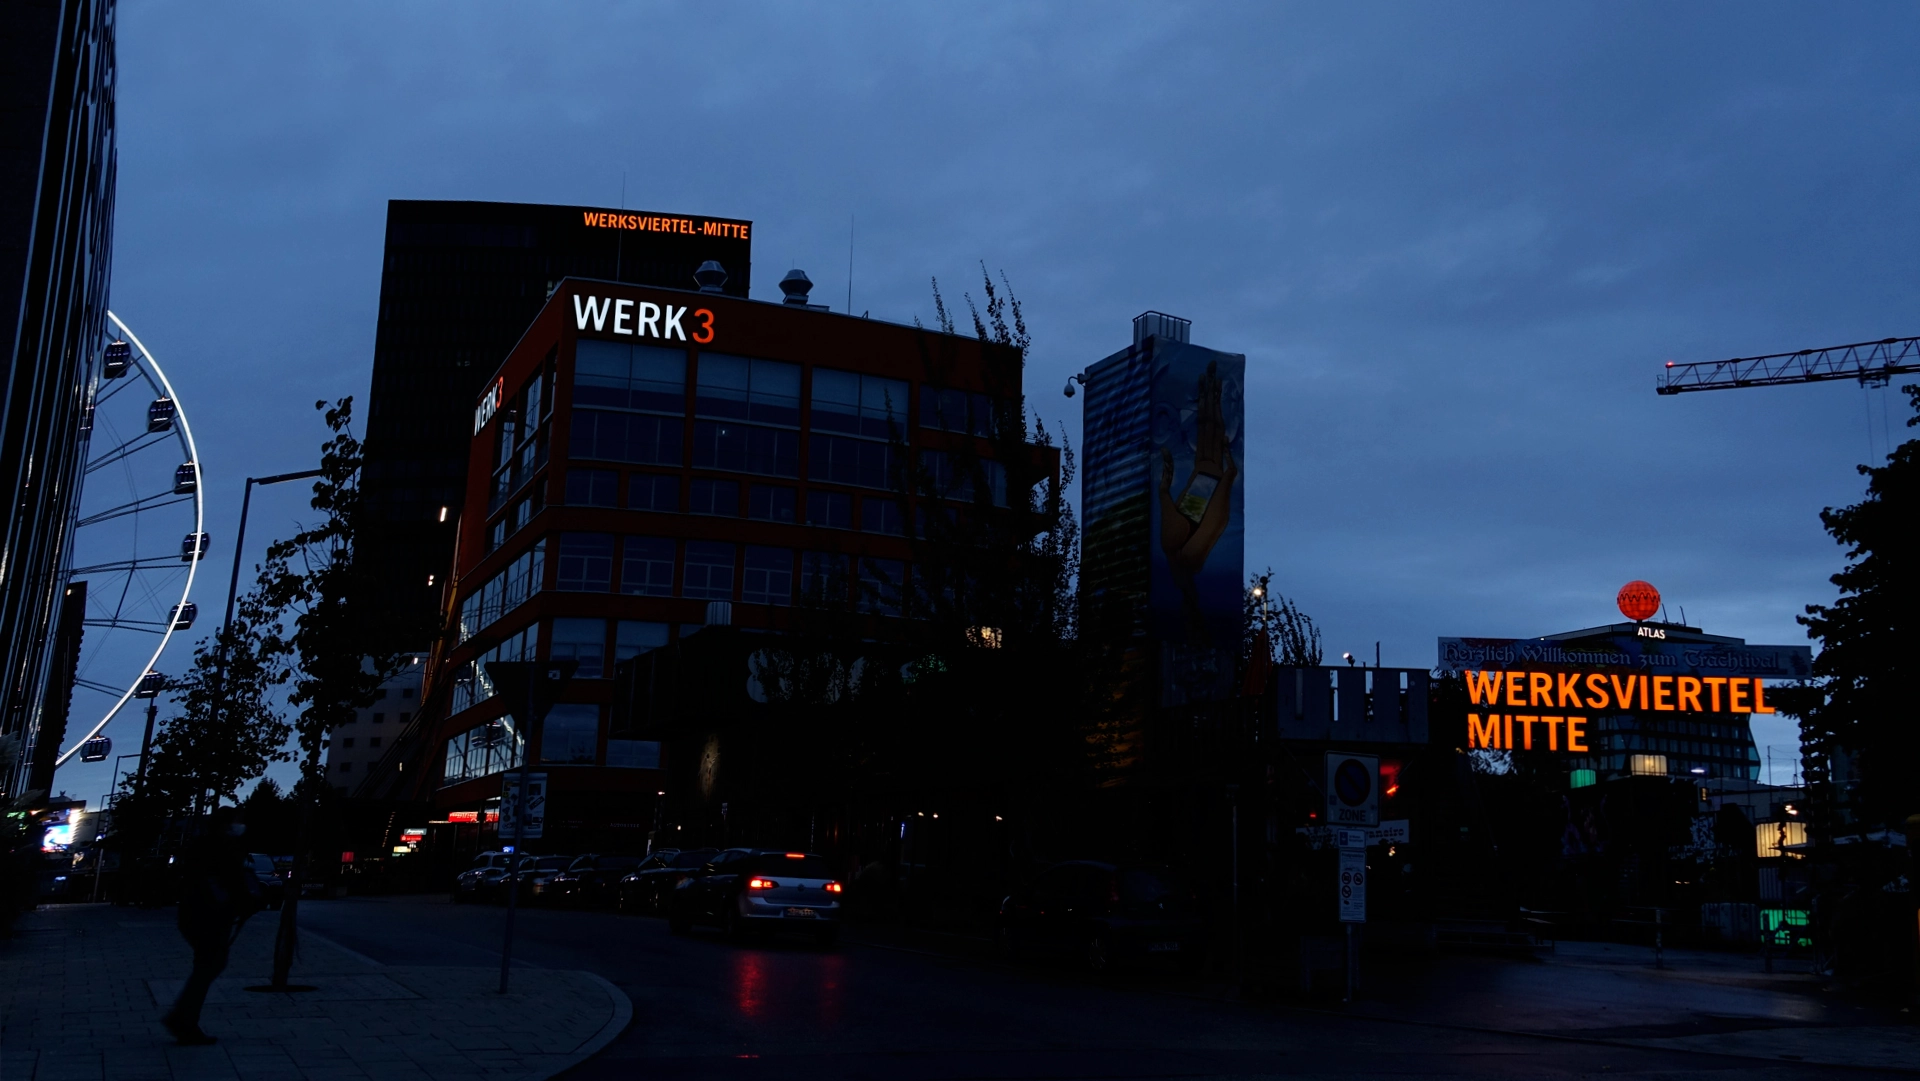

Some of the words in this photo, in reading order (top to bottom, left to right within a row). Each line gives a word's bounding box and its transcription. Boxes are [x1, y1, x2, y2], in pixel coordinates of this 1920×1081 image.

[583, 211, 750, 240] WERKSVIERTEL-MITTE
[572, 293, 716, 344] WERK3
[474, 375, 504, 437] WERK3
[1637, 626, 1667, 640] ATLAS
[1443, 641, 1517, 667] Herzlich
[1521, 646, 1631, 666] Willkommen
[1638, 653, 1678, 670] zum
[1465, 670, 1776, 714] WERKSVIERTEL
[1467, 713, 1590, 753] MITTE
[1339, 808, 1367, 822] ZONE
